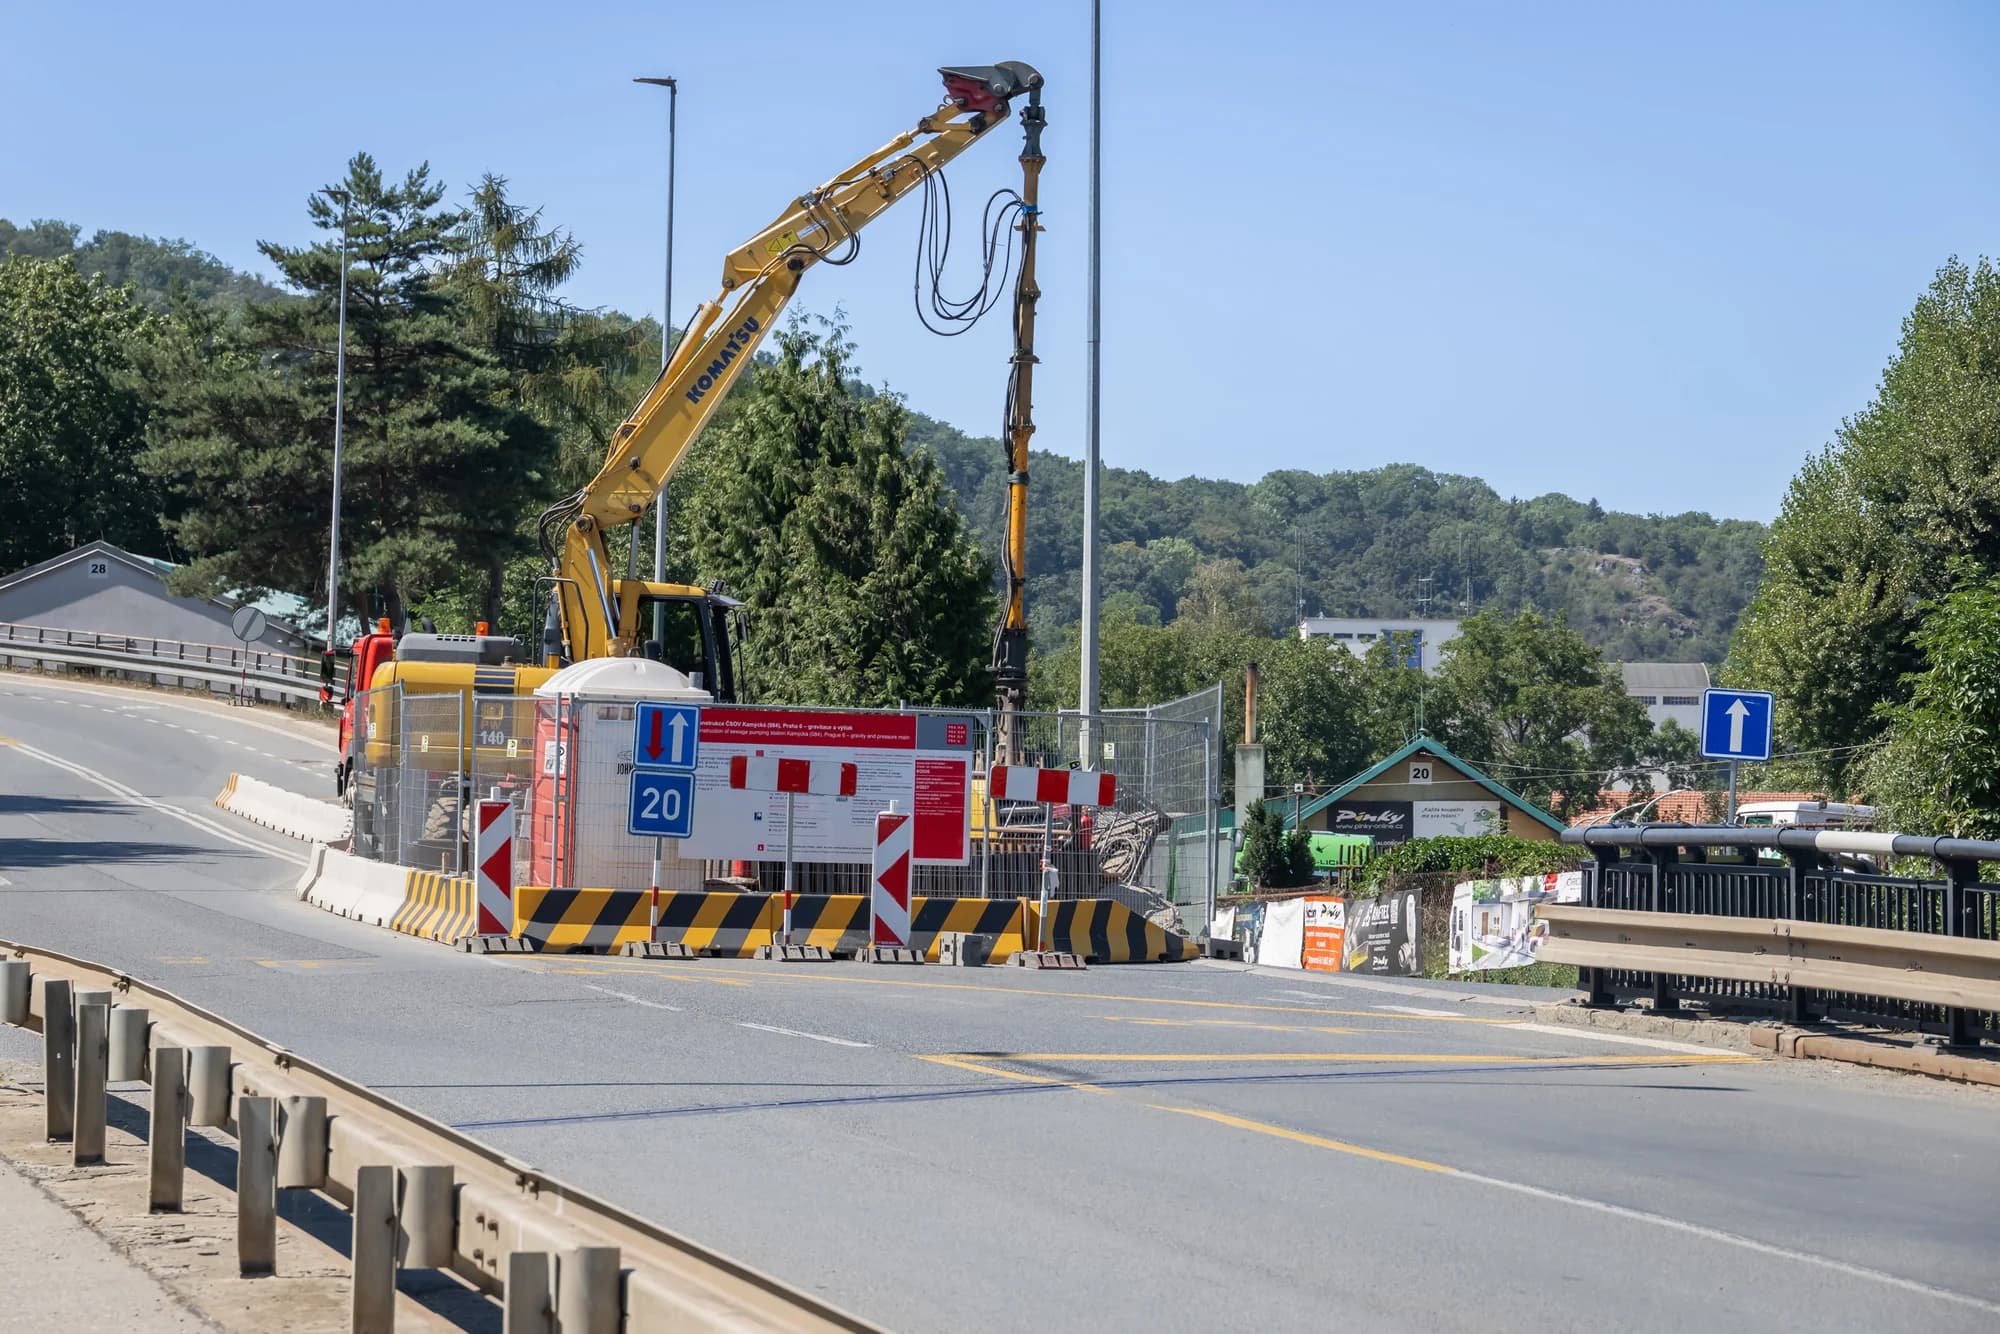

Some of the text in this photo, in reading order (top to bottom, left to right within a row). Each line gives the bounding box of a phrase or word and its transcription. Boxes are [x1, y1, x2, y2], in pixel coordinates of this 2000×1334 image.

[686, 316, 759, 404] KOMATSU
[91, 564, 106, 574] 28
[480, 731, 505, 745] 140
[1412, 768, 1429, 779] 20
[641, 787, 681, 821] 20
[1336, 810, 1405, 824] Pinky
